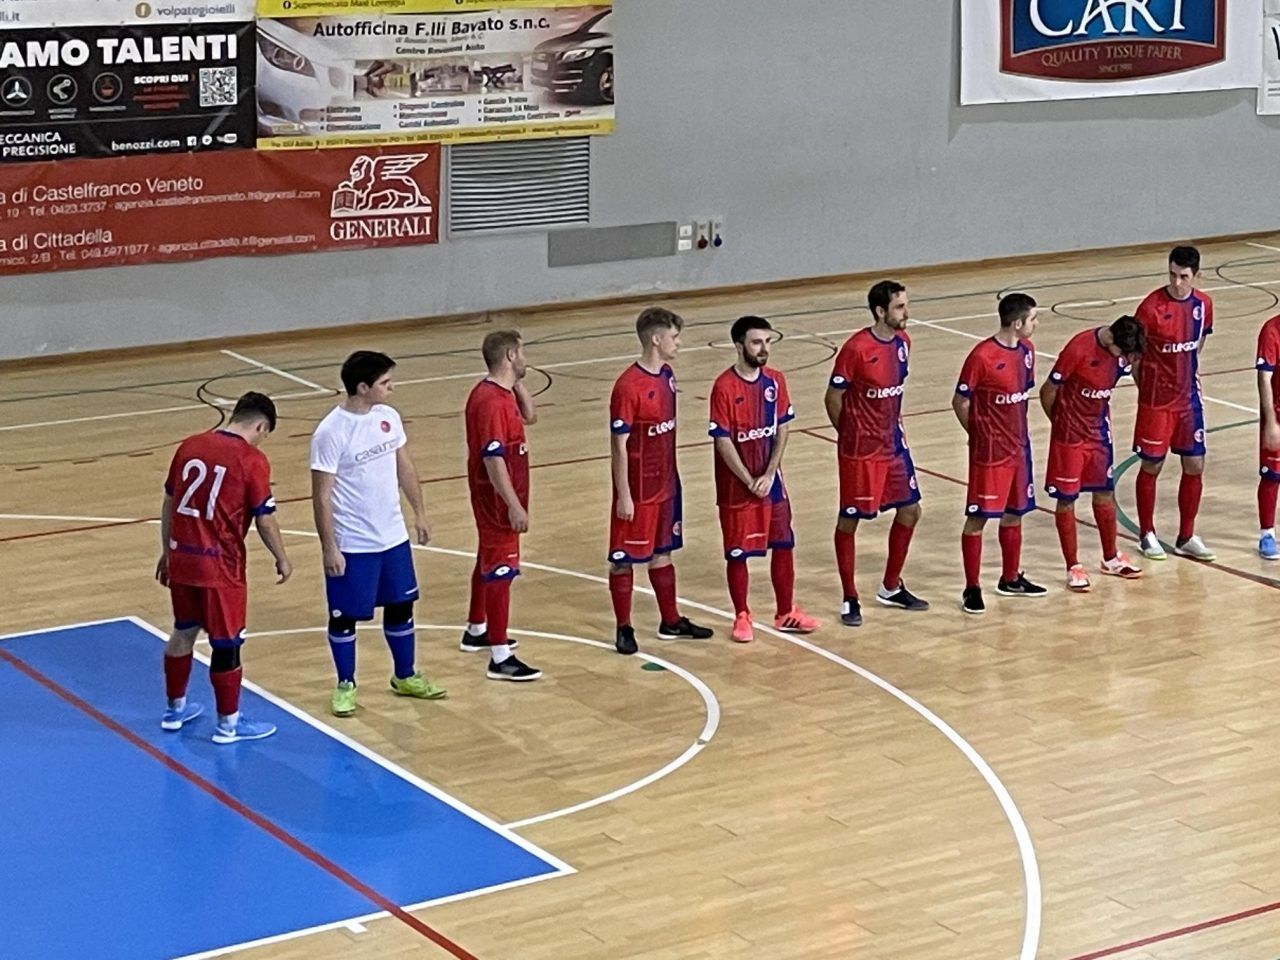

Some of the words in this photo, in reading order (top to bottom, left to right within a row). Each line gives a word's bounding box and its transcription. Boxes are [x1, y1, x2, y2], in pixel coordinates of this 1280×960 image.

[157, 3, 235, 19] volpatogioielli
[313, 22, 408, 38] Autofficina
[452, 17, 504, 35] Bavato
[509, 17, 550, 30] s.n.c.
[0, 39, 90, 68] AMO
[97, 34, 237, 65] TALENTI
[1041, 46, 1100, 68] QUALITY
[1105, 45, 1147, 59] TISSUE
[1147, 45, 1183, 60] PAPER
[134, 75, 170, 85] SCOPRI
[2, 143, 76, 157] PRECISIONE
[112, 138, 180, 151] benozzi.com
[12, 187, 28, 204] di
[33, 182, 142, 202] Castelfranco
[146, 176, 204, 194] Veneto
[330, 216, 431, 241] GENERALI
[12, 234, 28, 251] di
[33, 229, 113, 249] Cittadella
[176, 458, 228, 522] 21
